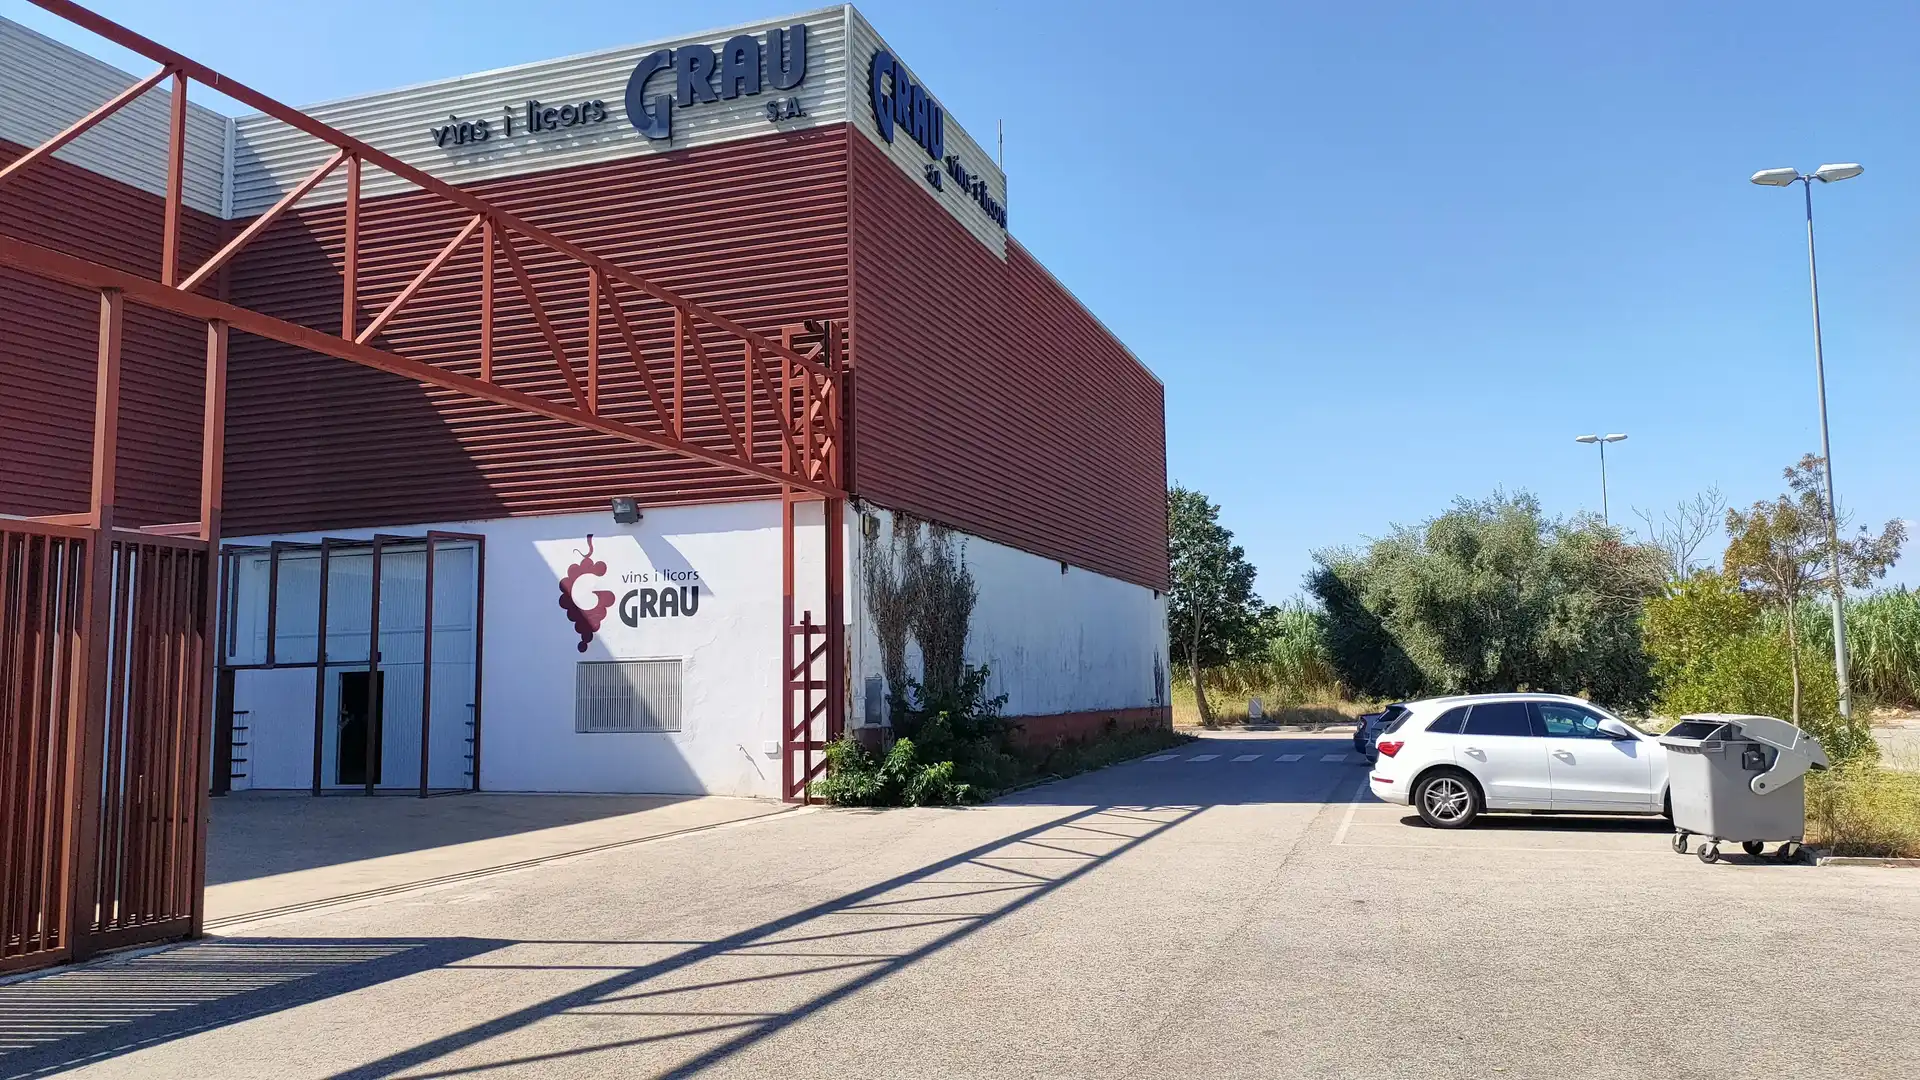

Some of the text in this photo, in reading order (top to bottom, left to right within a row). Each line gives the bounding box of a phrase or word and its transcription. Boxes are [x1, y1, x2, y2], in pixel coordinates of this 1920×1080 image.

[431, 23, 807, 147] vins i licors GRAU
[869, 49, 944, 161] GRAU
[766, 96, 807, 122] S.A.
[622, 568, 699, 584] vins i licors
[619, 585, 699, 628] GRAU
